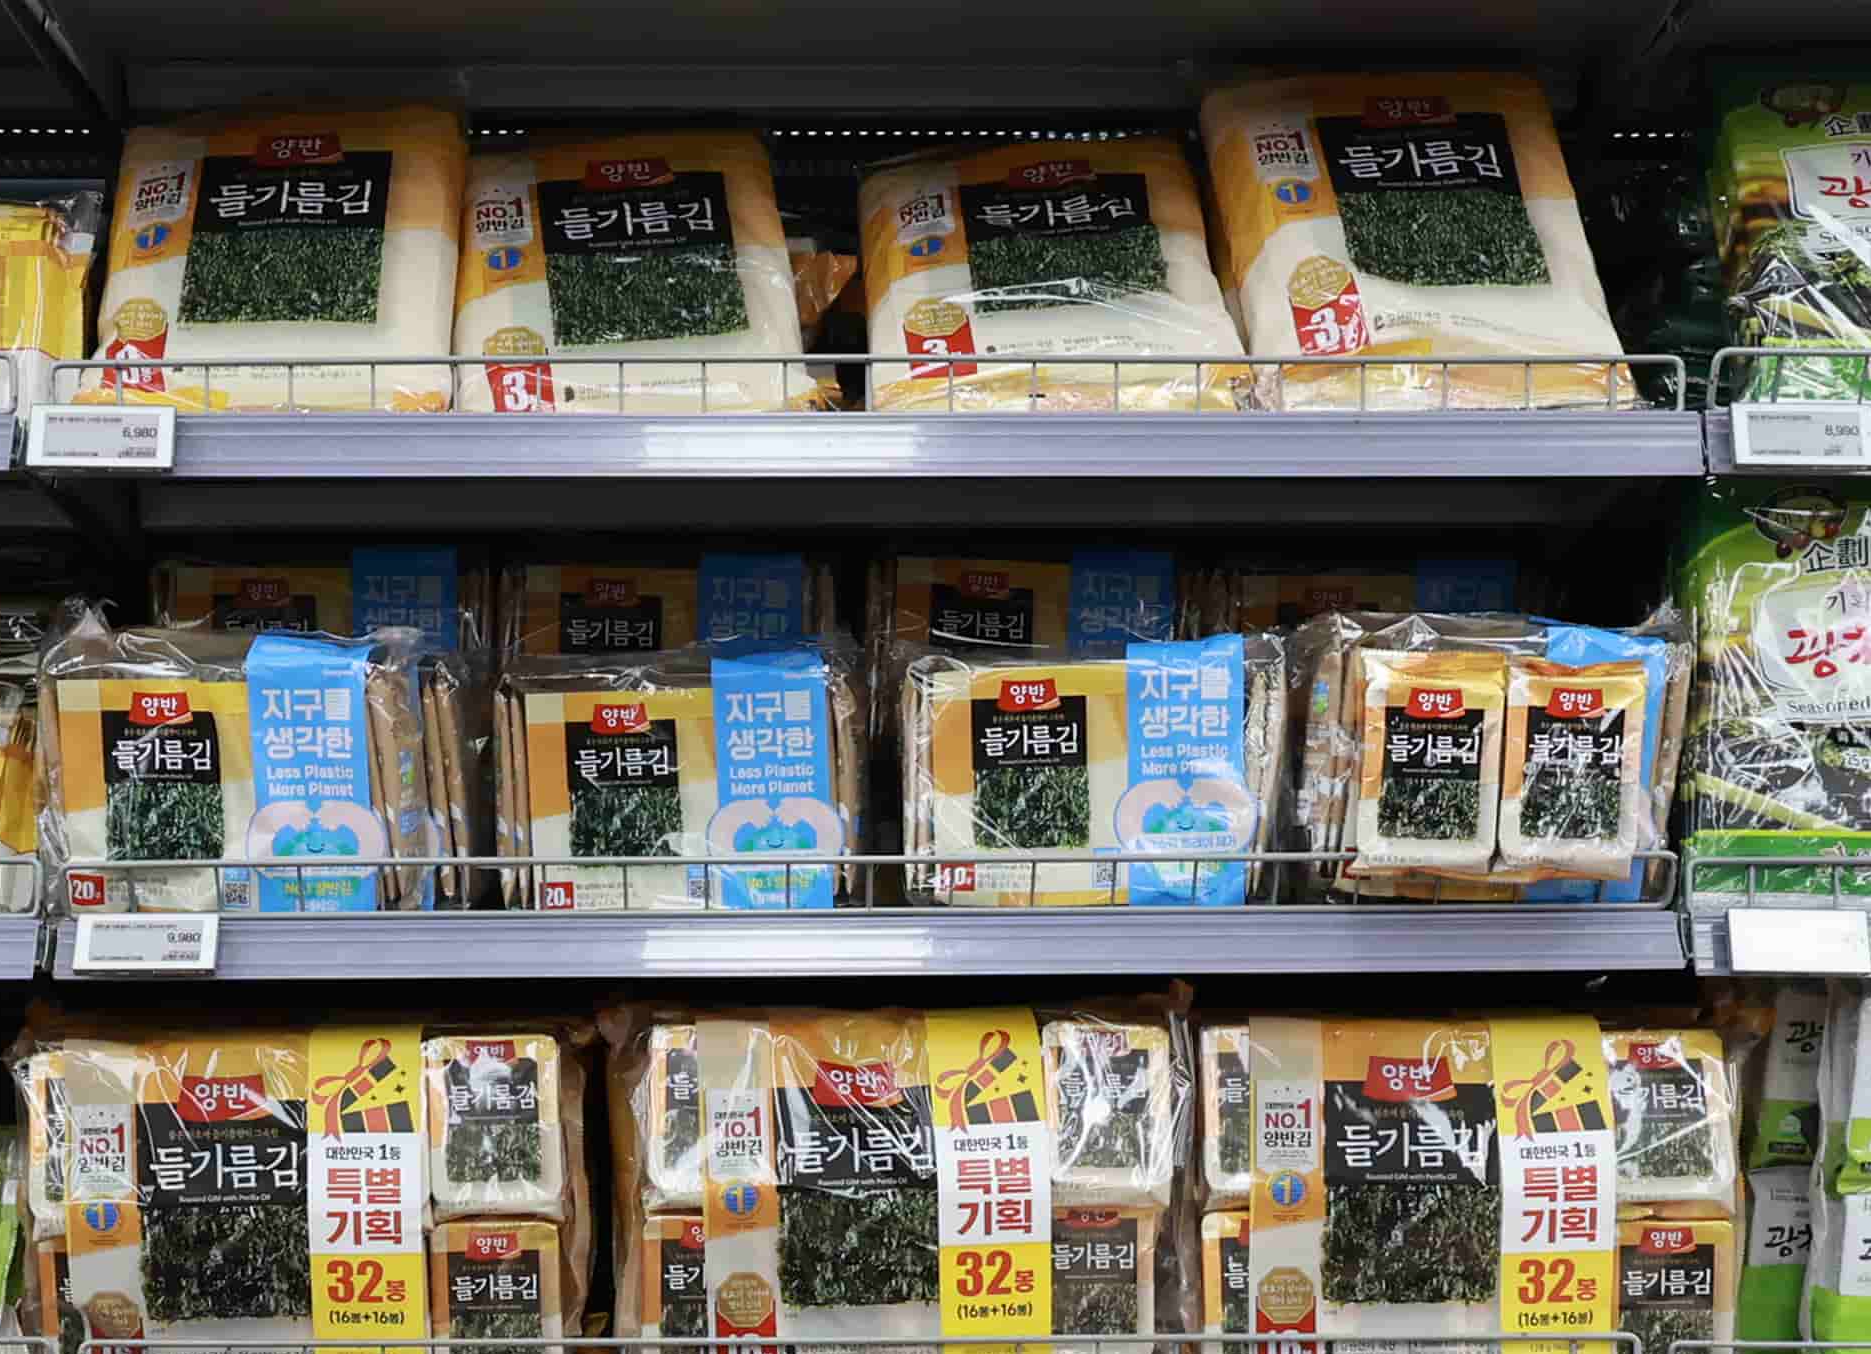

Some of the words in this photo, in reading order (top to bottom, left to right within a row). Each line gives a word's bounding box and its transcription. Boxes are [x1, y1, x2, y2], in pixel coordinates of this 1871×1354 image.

[270, 137, 322, 158] 양반
[1339, 140, 1505, 180] 들기름김
[600, 161, 652, 182] 양반
[210, 177, 374, 217] 들기름김
[975, 193, 1136, 231] 들기름김
[554, 196, 715, 237] 들기름김
[141, 695, 179, 718] 양반
[262, 688, 352, 722] 지구를
[725, 689, 813, 722] 지구를
[1008, 682, 1048, 707] 양반
[1418, 690, 1454, 714] 양반
[1787, 693, 1871, 717] Seasoned
[978, 718, 1079, 758] 들기름김
[1139, 705, 1228, 739] 생각한
[110, 737, 212, 772] 들기름김
[262, 726, 353, 760] 생각한
[727, 727, 816, 760] 생각한
[1140, 745, 1176, 760] Less
[265, 764, 300, 781] Less
[304, 764, 354, 782] Plastic
[267, 781, 302, 797] More
[307, 781, 355, 798] Planet
[730, 781, 764, 797] More
[769, 781, 817, 798] Planet
[195, 1082, 247, 1110] 양반
[325, 1146, 375, 1160] 대한민국
[378, 1144, 401, 1160] 1등
[715, 1137, 763, 1157] 양반김
[953, 1137, 1002, 1152] 대한민국
[1006, 1134, 1028, 1150] 1등
[1265, 1130, 1312, 1147] 양반김
[150, 1144, 300, 1193] 들기름김
[956, 1159, 1033, 1194] 특별
[1523, 1166, 1597, 1200] 특별
[326, 1167, 401, 1205] 특별
[326, 1209, 402, 1246] 기획
[958, 1200, 1033, 1236] 기획
[1523, 1209, 1597, 1244] 기획
[1650, 1229, 1684, 1247] 양반
[451, 1273, 538, 1302] 들기름김
